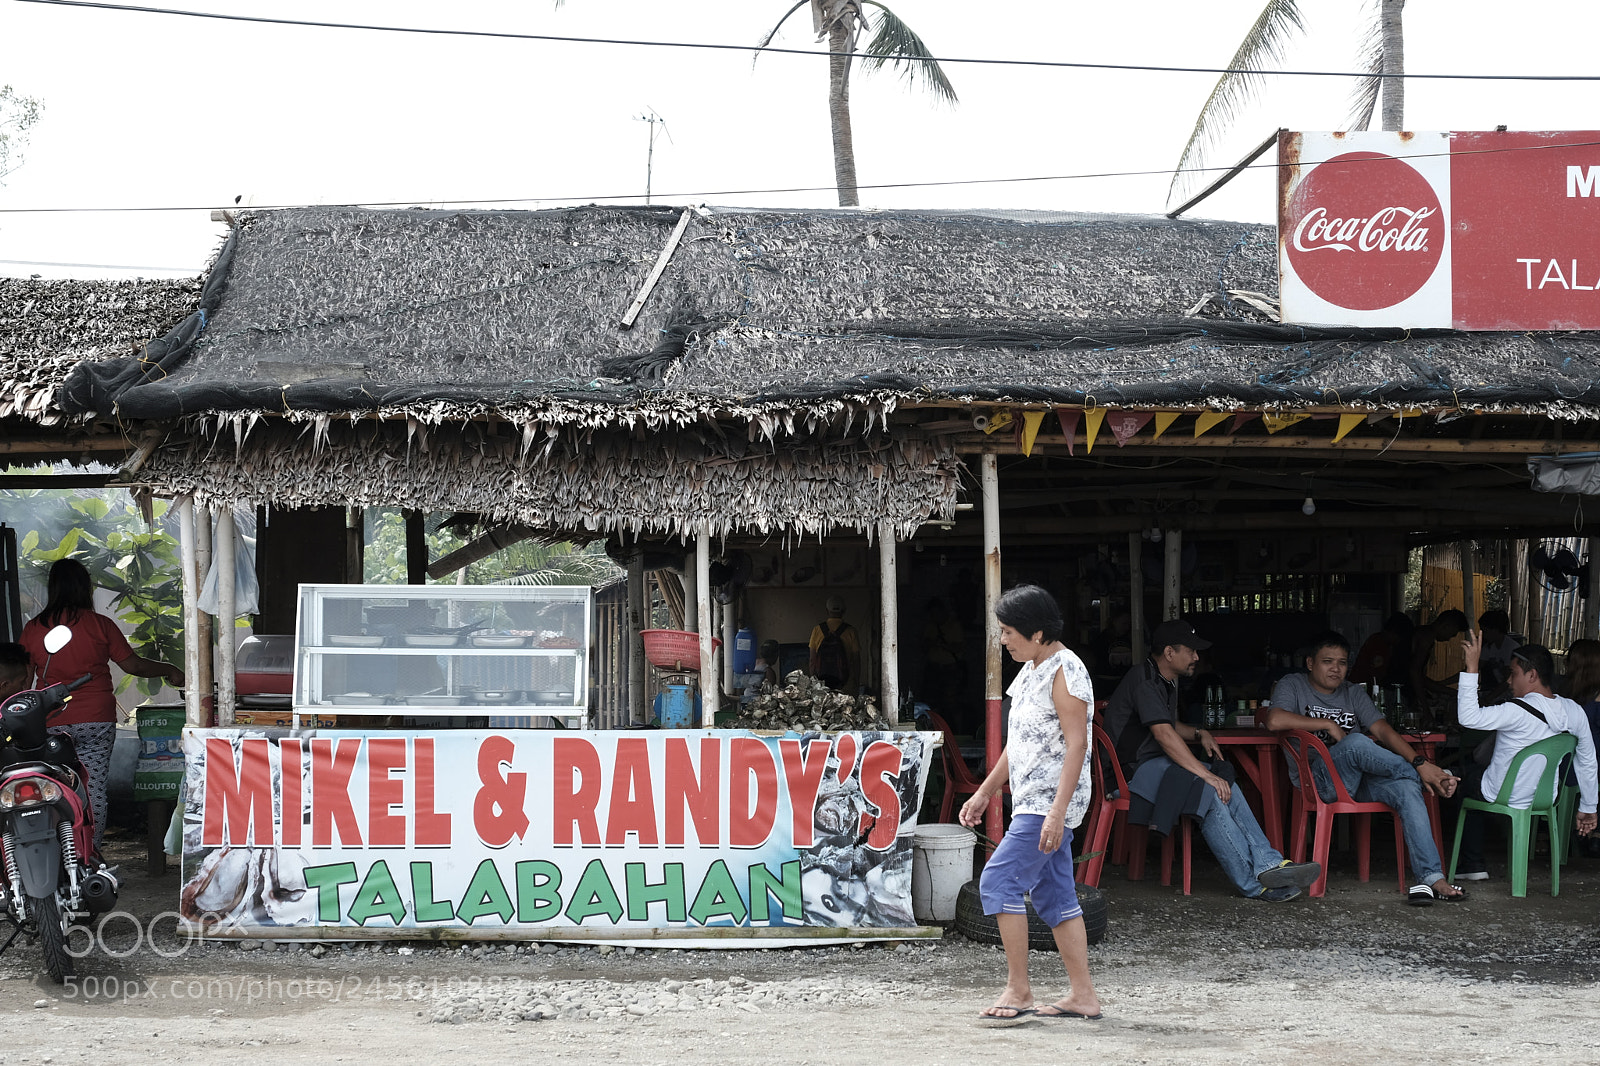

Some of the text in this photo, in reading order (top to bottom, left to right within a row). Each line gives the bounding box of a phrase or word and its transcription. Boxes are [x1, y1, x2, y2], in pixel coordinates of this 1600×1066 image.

[1293, 207, 1437, 252] Coca-Cola
[1516, 258, 1600, 291] TAL
[201, 734, 902, 852] MIKEL & RANDY'S
[303, 858, 803, 926] TALABAHAN
